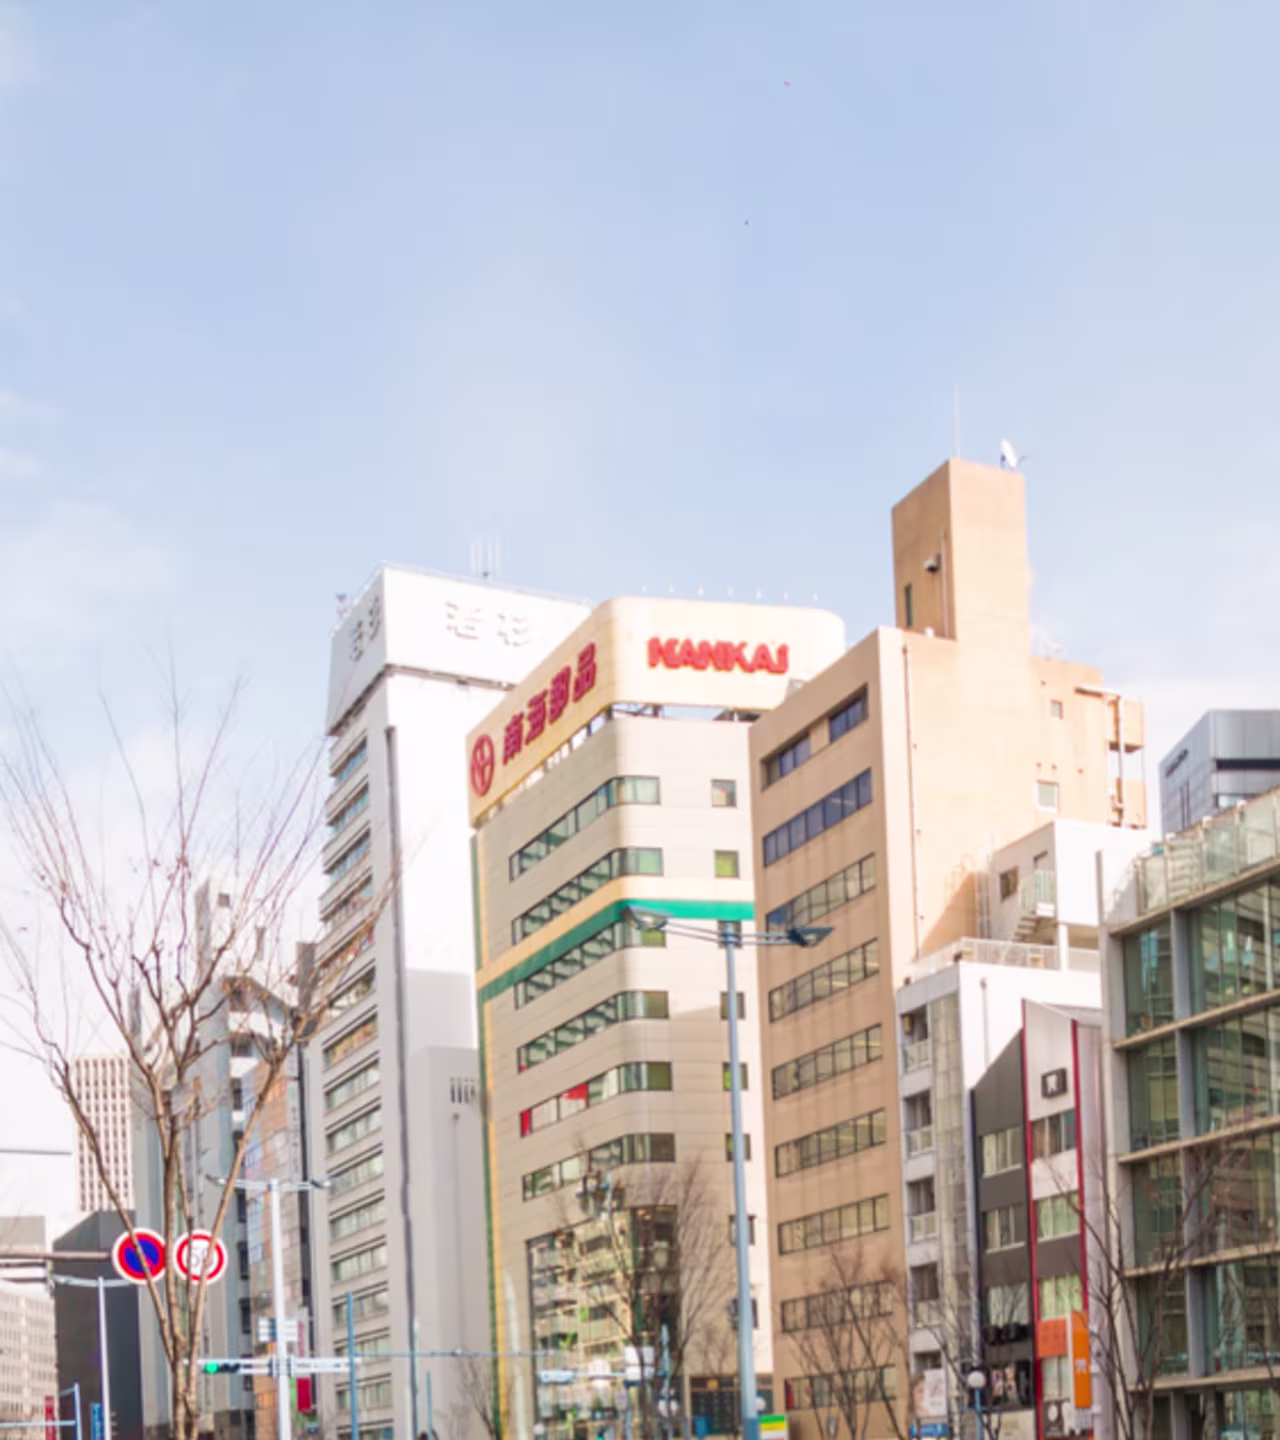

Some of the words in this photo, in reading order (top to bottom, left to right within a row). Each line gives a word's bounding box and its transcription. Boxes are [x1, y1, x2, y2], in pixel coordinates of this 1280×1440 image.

[647, 637, 789, 675] NANKAI
[502, 641, 597, 767] 南海部品
